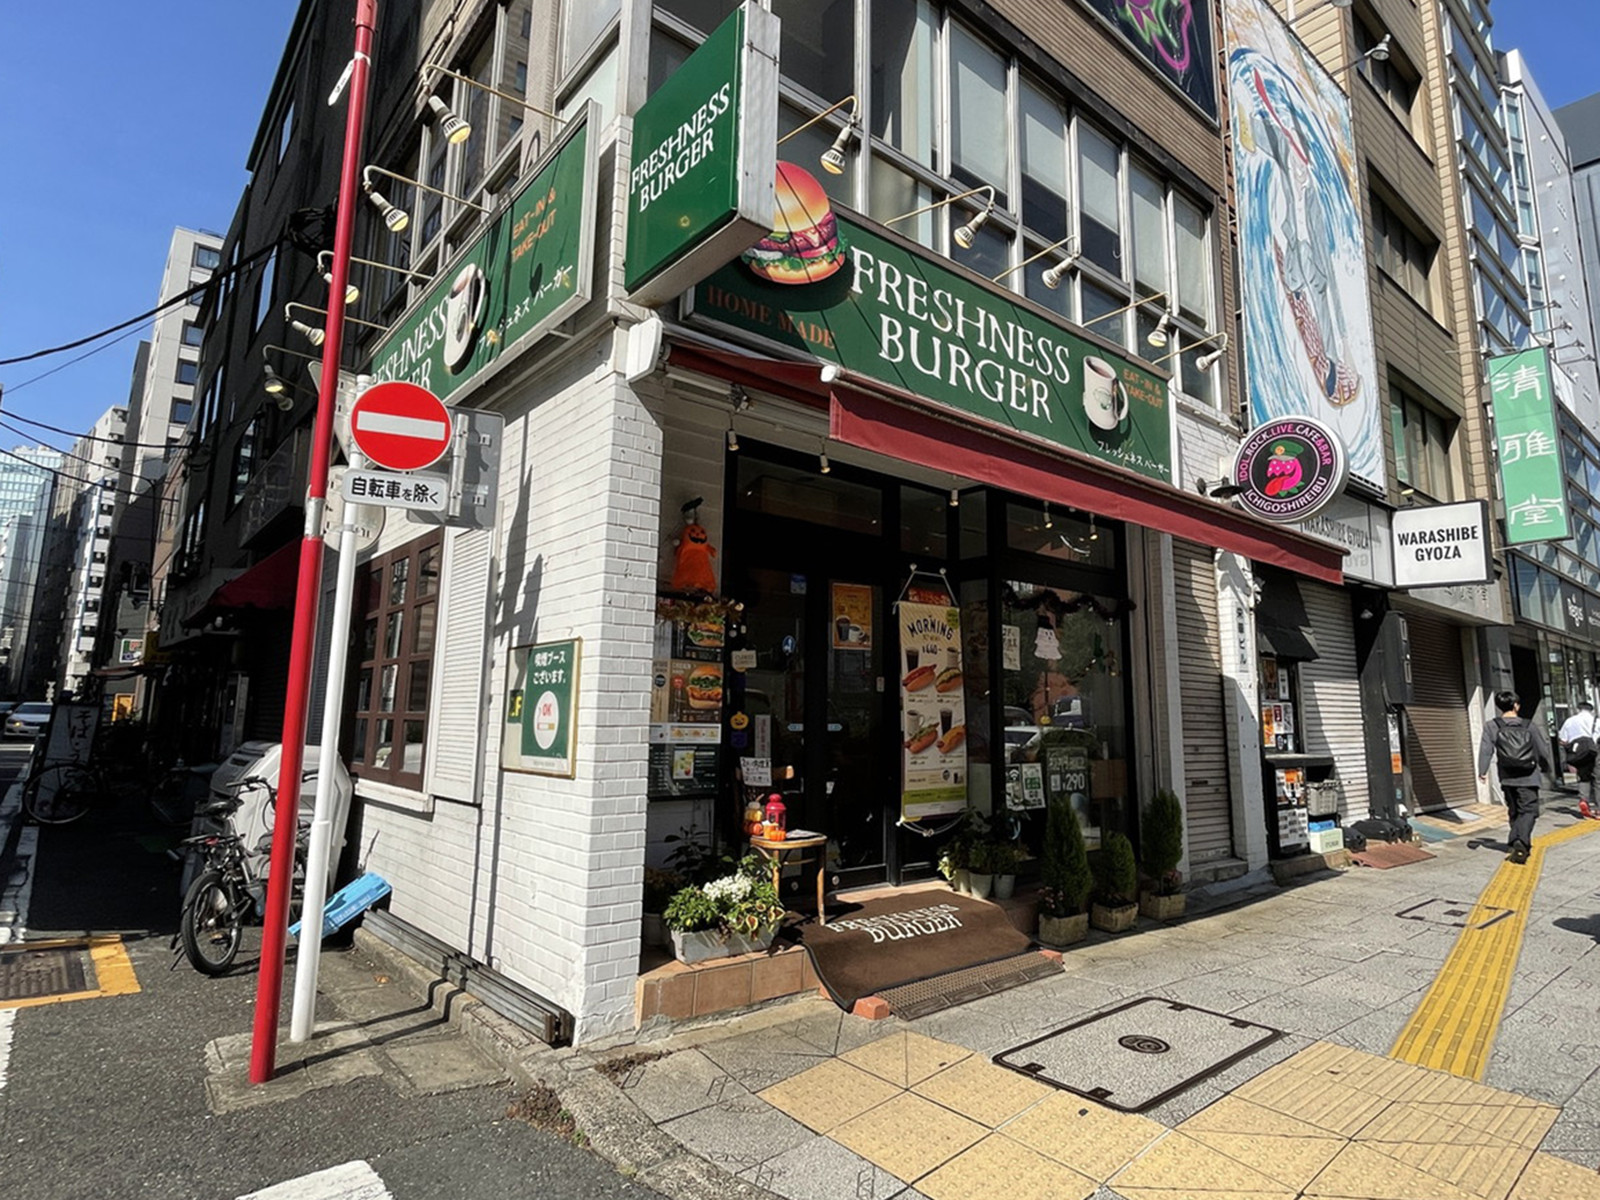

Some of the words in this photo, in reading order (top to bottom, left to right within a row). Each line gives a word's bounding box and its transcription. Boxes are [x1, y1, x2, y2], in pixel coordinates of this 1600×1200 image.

[630, 83, 730, 195] FRESHNESS
[639, 128, 715, 213] BURGER
[706, 284, 771, 326] HOME
[777, 309, 836, 350] MADE
[850, 245, 1071, 385] FRESHNESS
[879, 314, 1054, 424] BURGER
[351, 476, 438, 505] 自転車を除く
[1397, 524, 1479, 547] WARASHIBE
[1415, 545, 1462, 562] GYOZA
[907, 618, 954, 641] MORNING
[826, 902, 960, 933] FRESHNESS
[862, 913, 963, 944] BURGER
